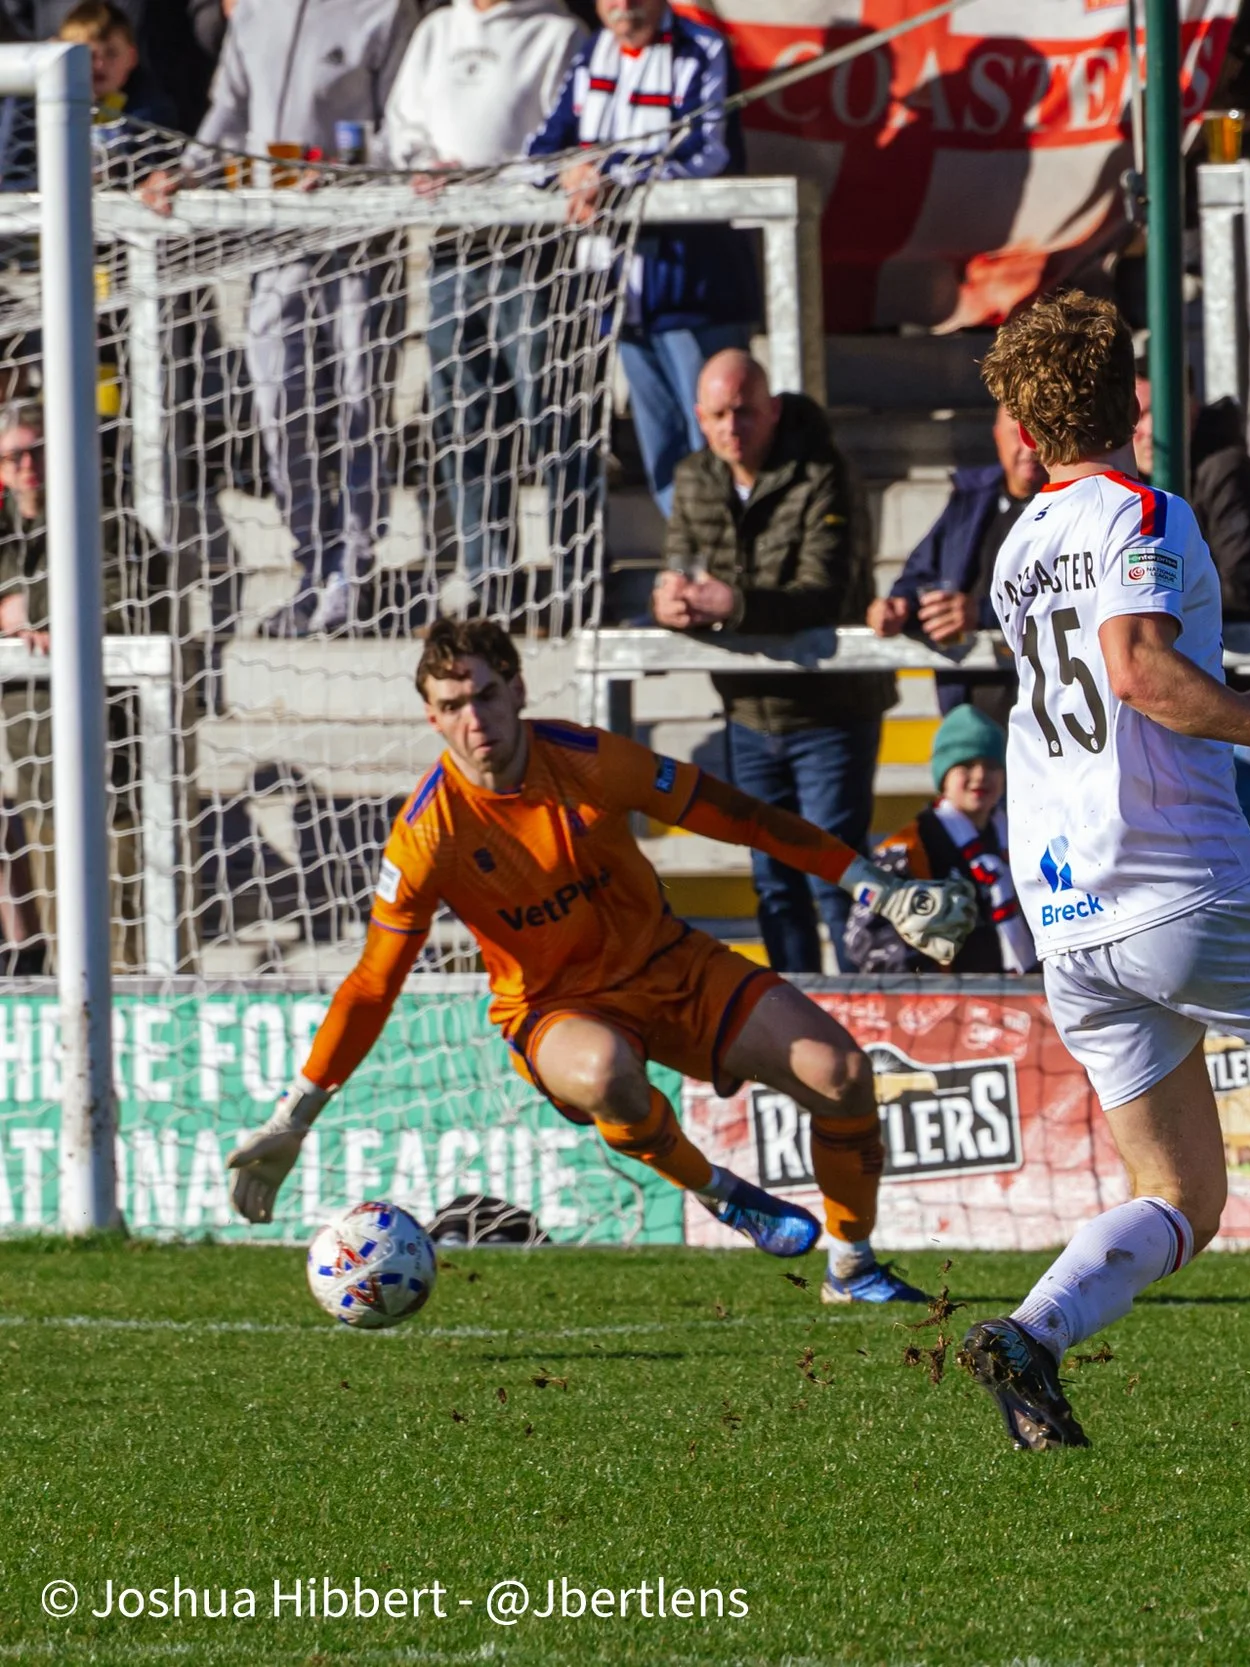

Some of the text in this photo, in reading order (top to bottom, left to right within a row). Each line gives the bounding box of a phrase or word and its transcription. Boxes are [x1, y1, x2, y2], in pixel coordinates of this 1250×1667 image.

[762, 36, 1214, 137] COASTES
[1020, 606, 1108, 757] 15
[1041, 893, 1104, 926] Breck
[301, 1127, 580, 1228] LEAGUE
